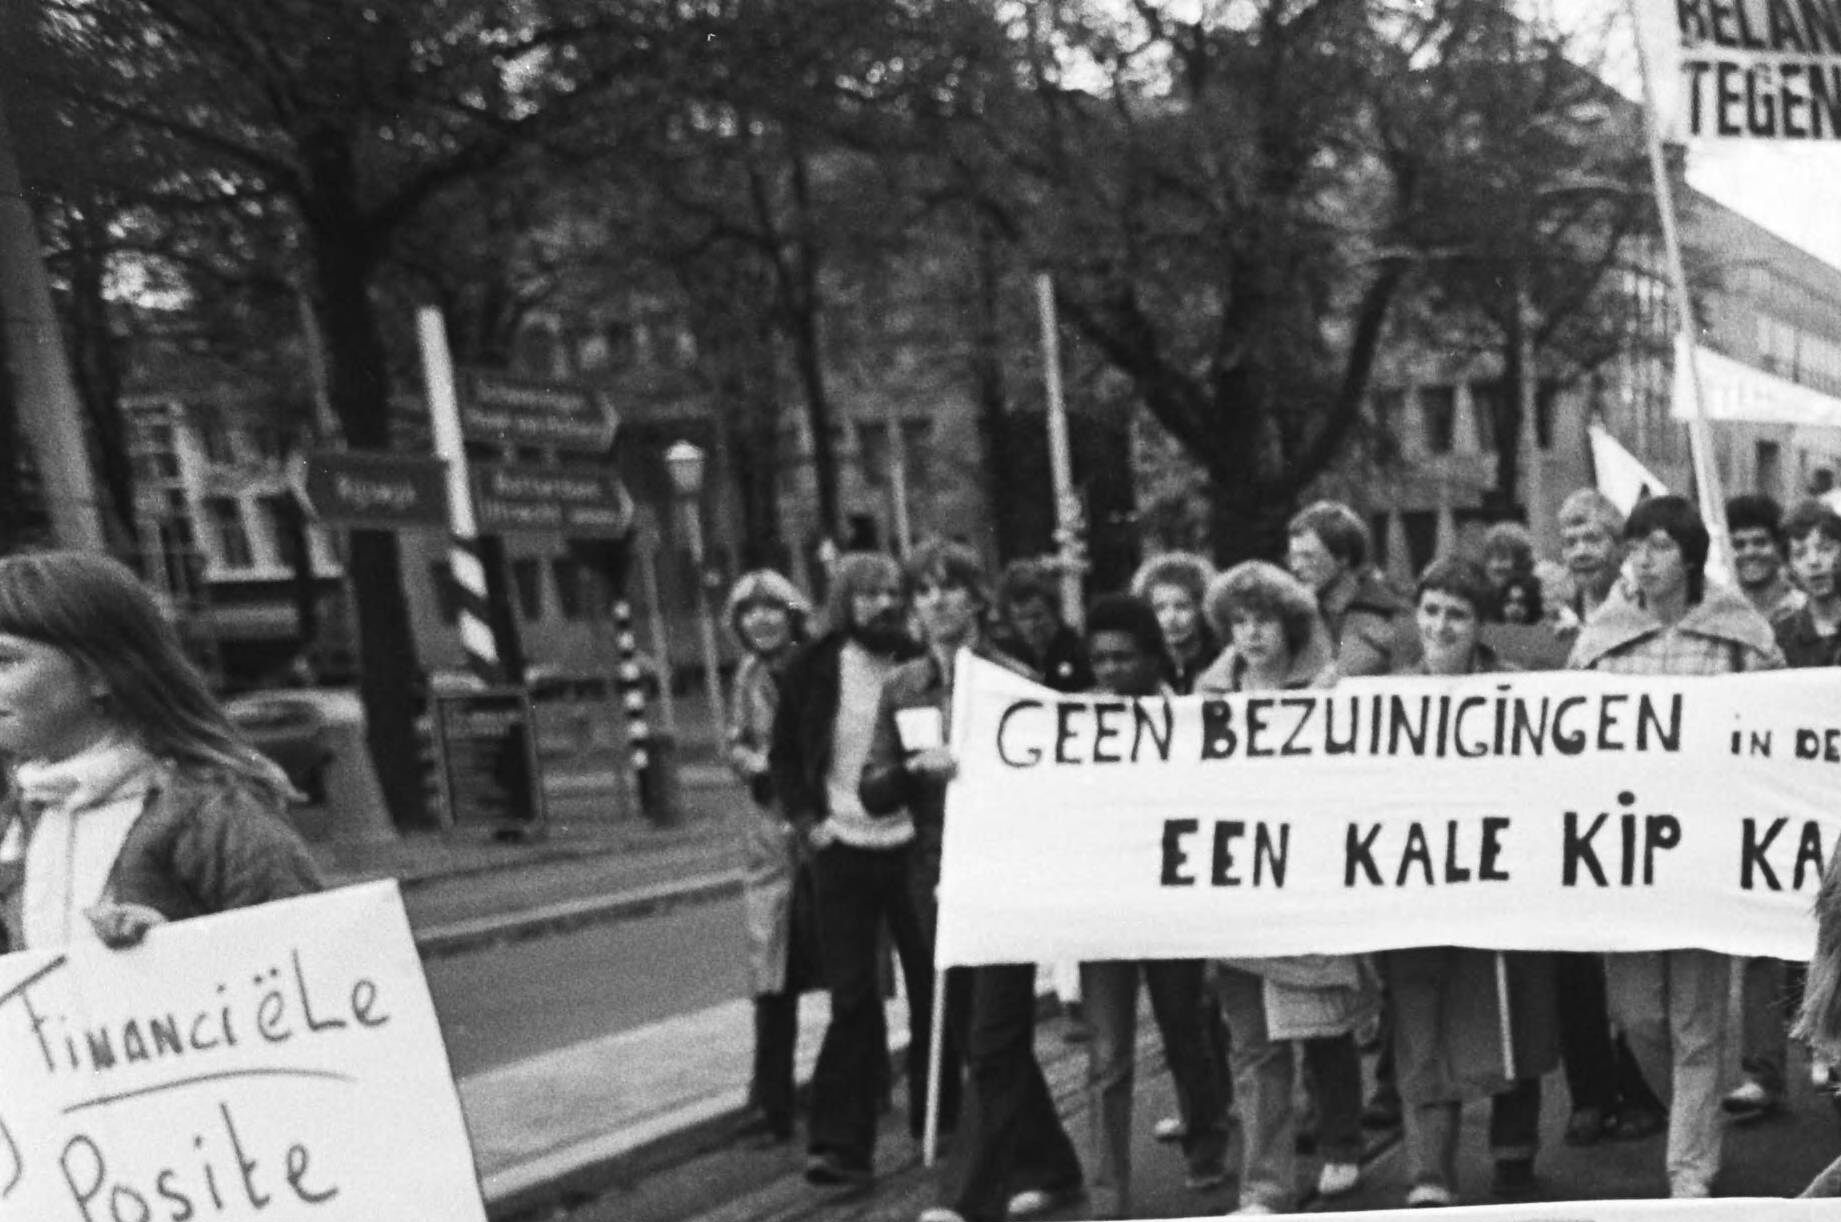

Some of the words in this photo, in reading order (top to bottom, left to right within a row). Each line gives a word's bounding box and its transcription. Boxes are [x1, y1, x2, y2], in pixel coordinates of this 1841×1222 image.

[998, 698, 1174, 768] GEEN
[1200, 684, 1683, 760] BEZUINIGINGEN
[1794, 728, 1841, 763] DE
[1160, 819, 1290, 888] EEN
[1343, 816, 1510, 888] KALE
[1740, 816, 1826, 891] KA
